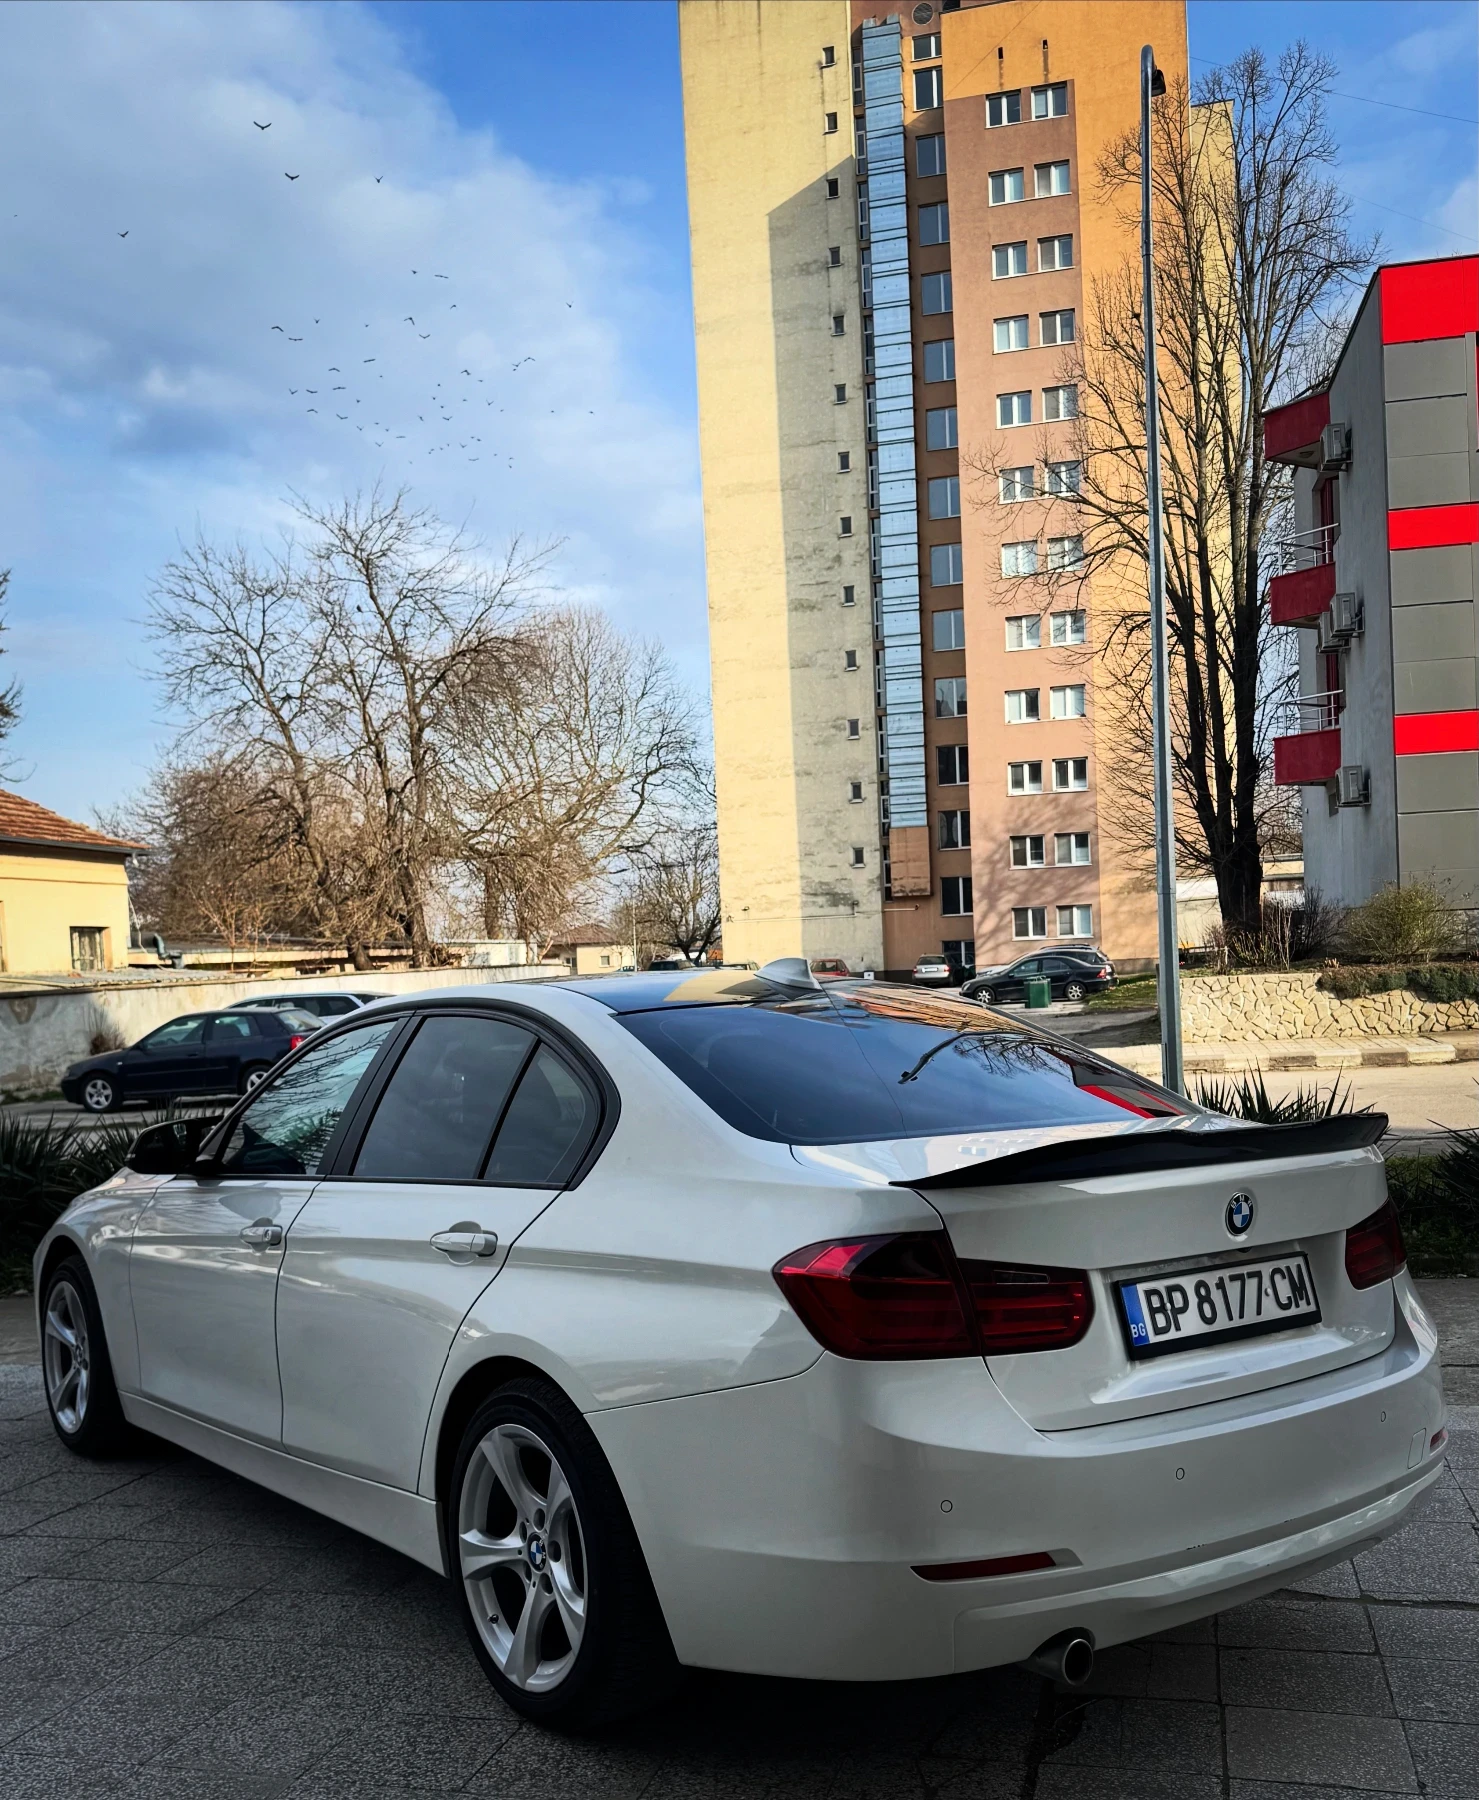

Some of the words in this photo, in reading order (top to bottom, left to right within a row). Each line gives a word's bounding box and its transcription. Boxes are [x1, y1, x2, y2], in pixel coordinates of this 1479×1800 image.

[1143, 1283, 1189, 1336] BP
[1194, 1269, 1263, 1325] 8177
[1269, 1263, 1311, 1311] CM
[1130, 1323, 1146, 1338] BG
